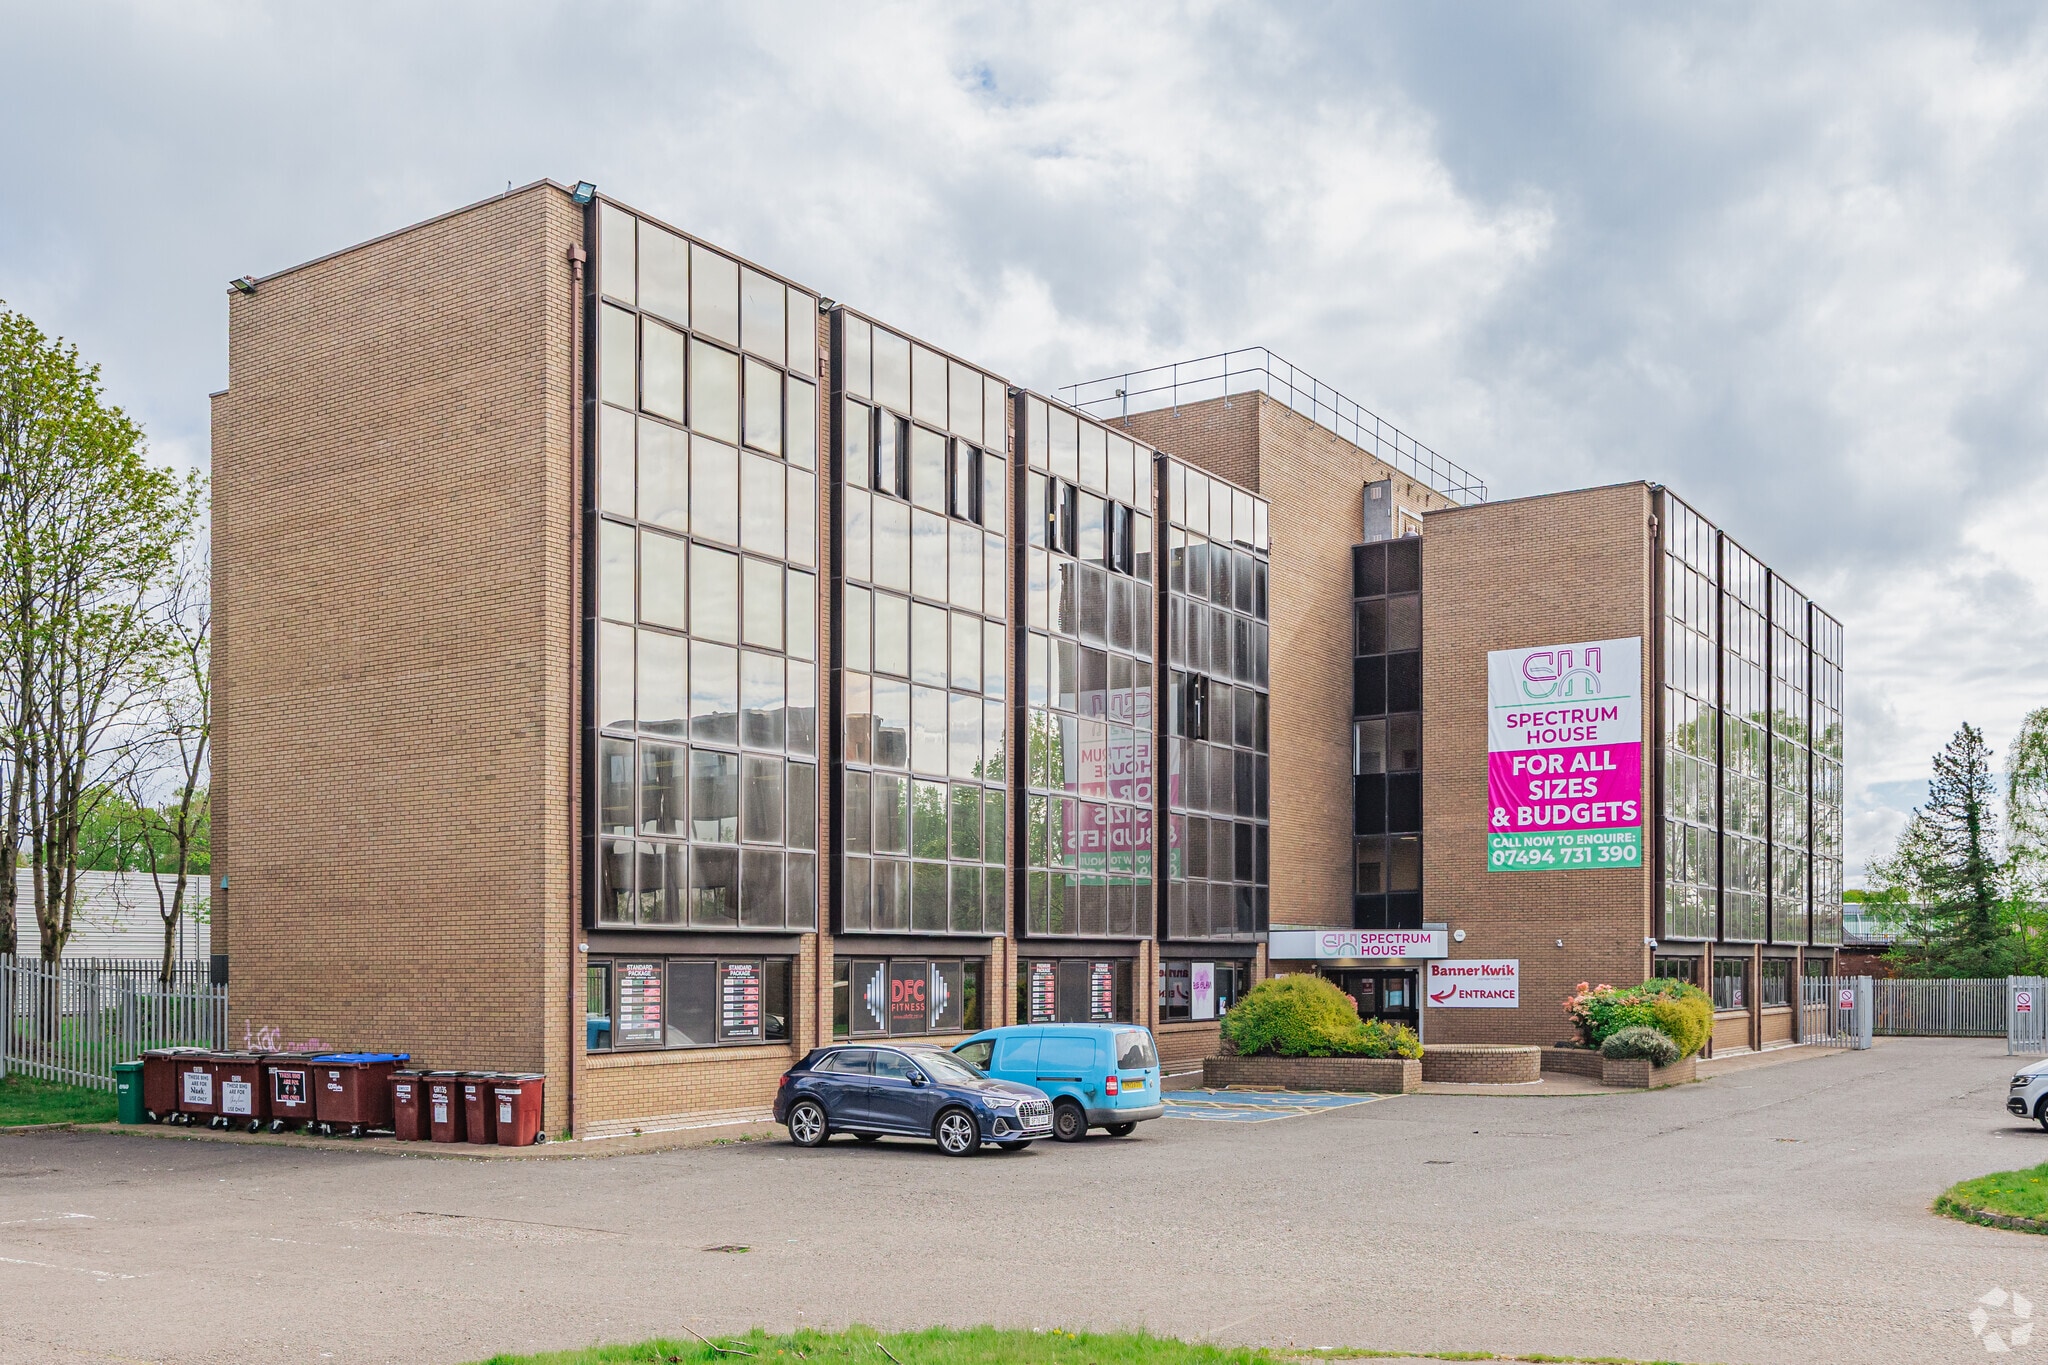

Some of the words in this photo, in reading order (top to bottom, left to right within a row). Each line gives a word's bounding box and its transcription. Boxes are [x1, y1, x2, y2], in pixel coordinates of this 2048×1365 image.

[1506, 705, 1618, 728] SPECTRUM
[1527, 725, 1597, 744] HOUSE
[1512, 754, 1564, 776] FOR
[1569, 750, 1617, 773] ALL
[1528, 777, 1598, 801] SIZES
[1491, 807, 1511, 826] &
[1517, 800, 1638, 826] BUDGETS
[1492, 837, 1521, 848] CALL
[1523, 836, 1555, 847] NOW
[1557, 835, 1574, 845] TO
[1577, 832, 1636, 845] ENQUIRE:
[1492, 849, 1555, 866] 07494
[1560, 847, 1592, 864] 731
[1597, 845, 1637, 862] 390
[1360, 933, 1431, 944] SPECTRUM
[1360, 945, 1406, 956] HOUSE
[891, 979, 926, 1002] DFC
[1458, 989, 1515, 999] ENTRANCE
[891, 1003, 925, 1012] FITNESS
